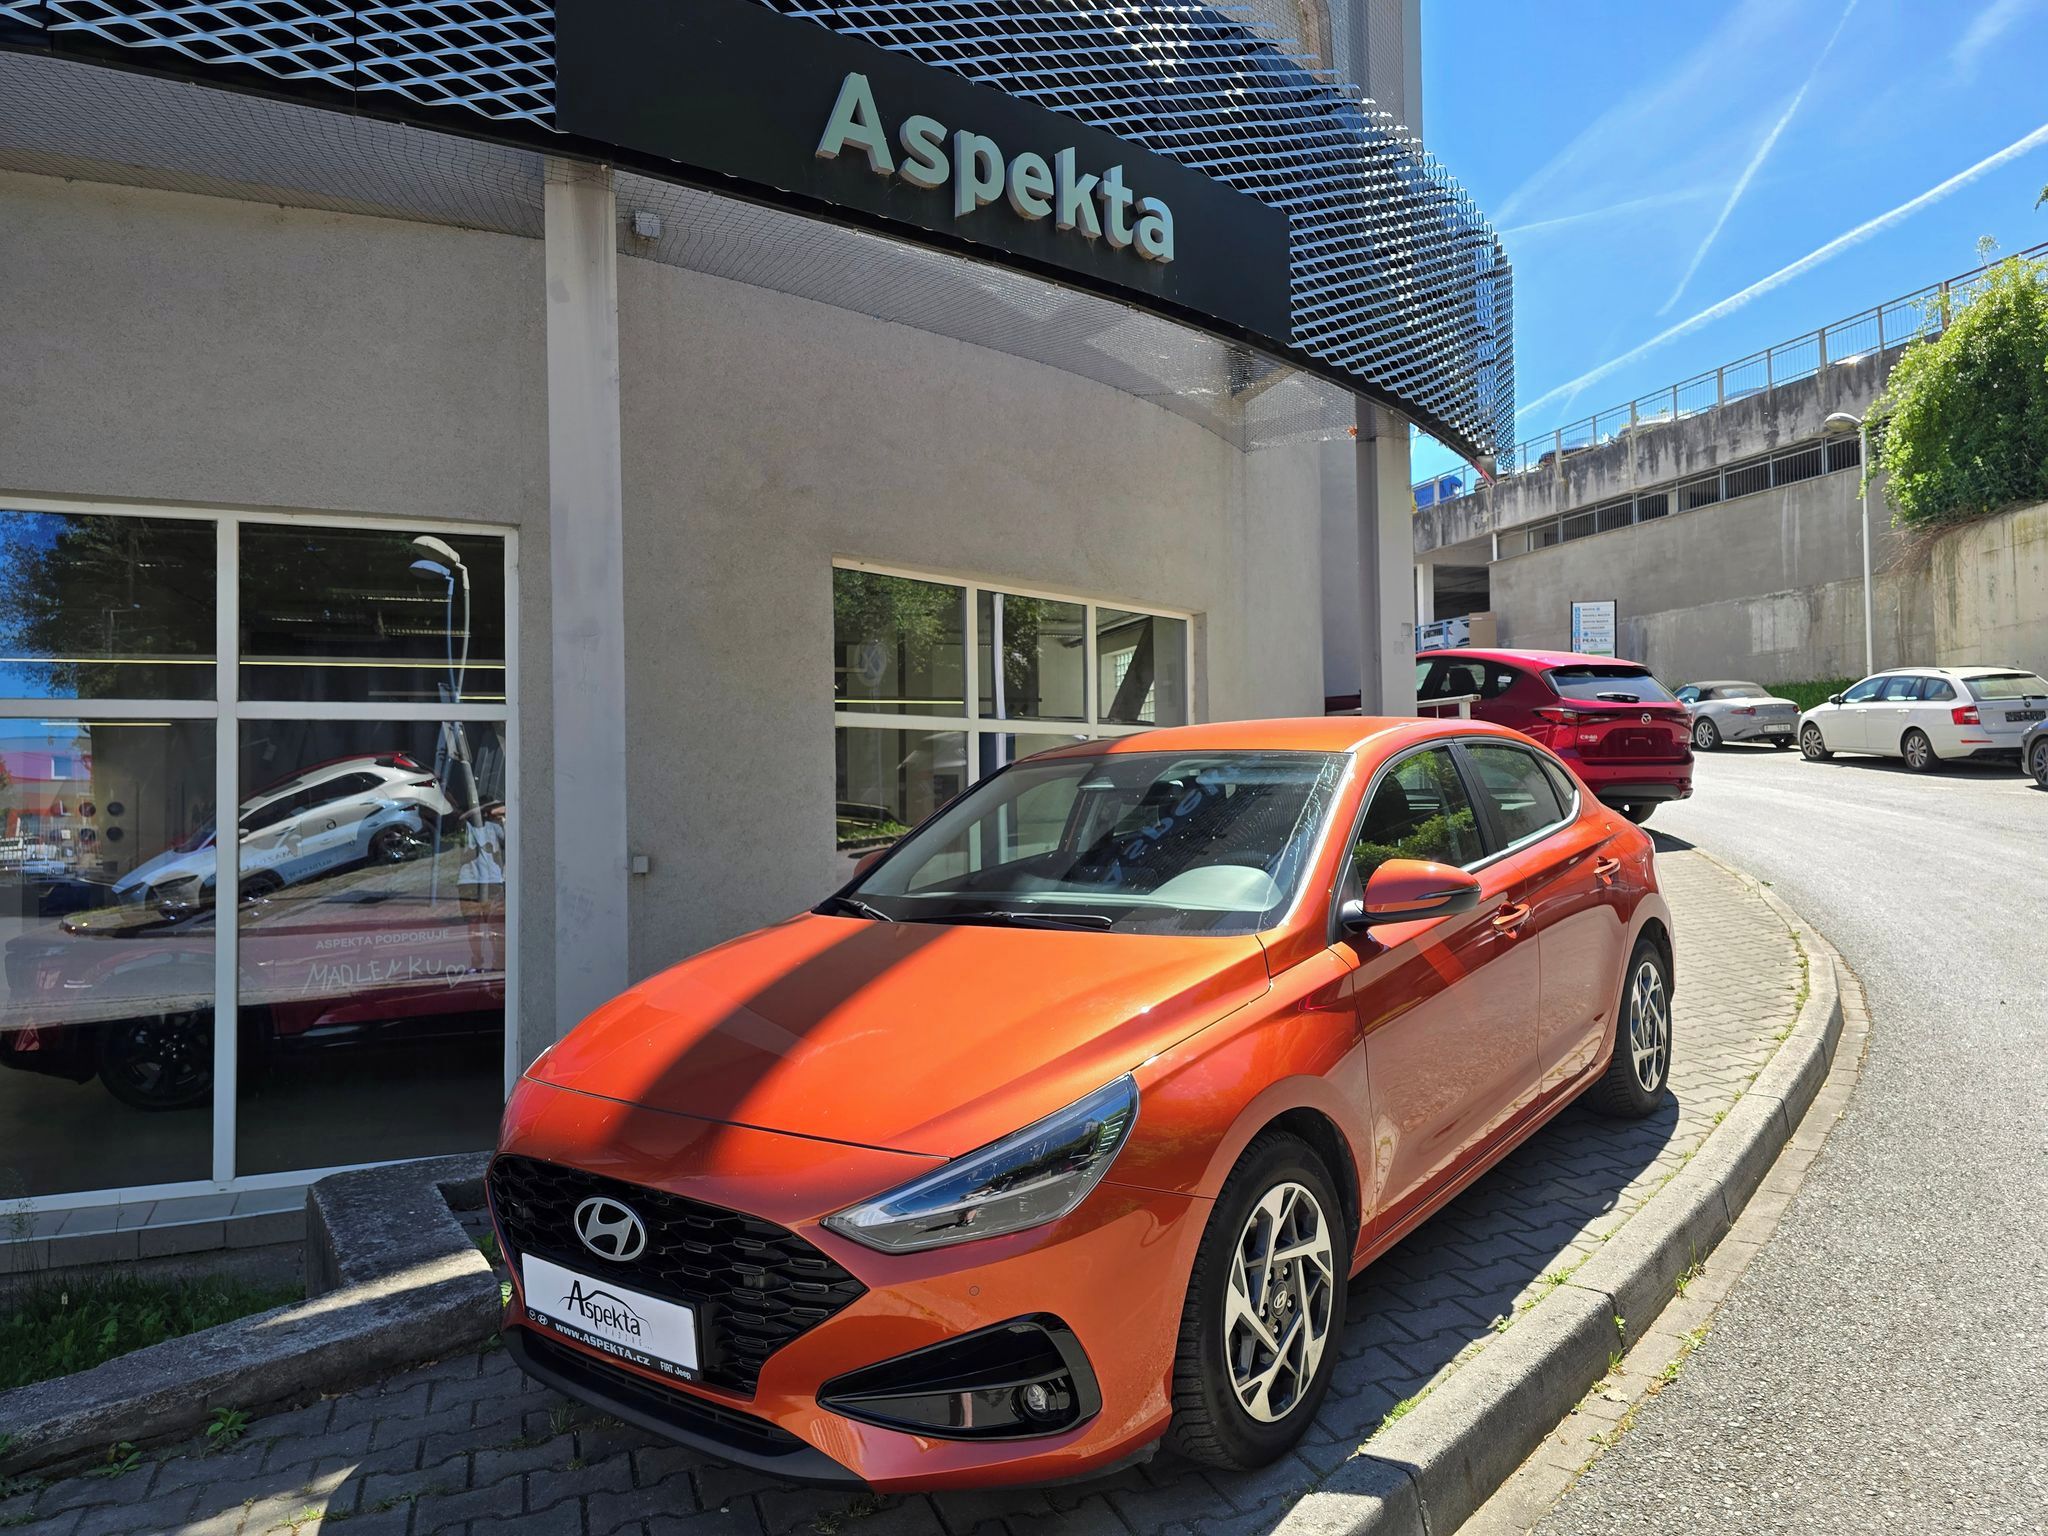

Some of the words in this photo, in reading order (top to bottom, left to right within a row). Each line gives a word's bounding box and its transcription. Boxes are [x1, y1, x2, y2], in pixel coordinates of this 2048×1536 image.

[815, 71, 1175, 264] Aspekta
[315, 935, 373, 950] ASPEKTA
[375, 928, 449, 945] PODPORUJE
[567, 1279, 641, 1337] Aspekta
[554, 1322, 651, 1366] www.ASPEKTA.cz
